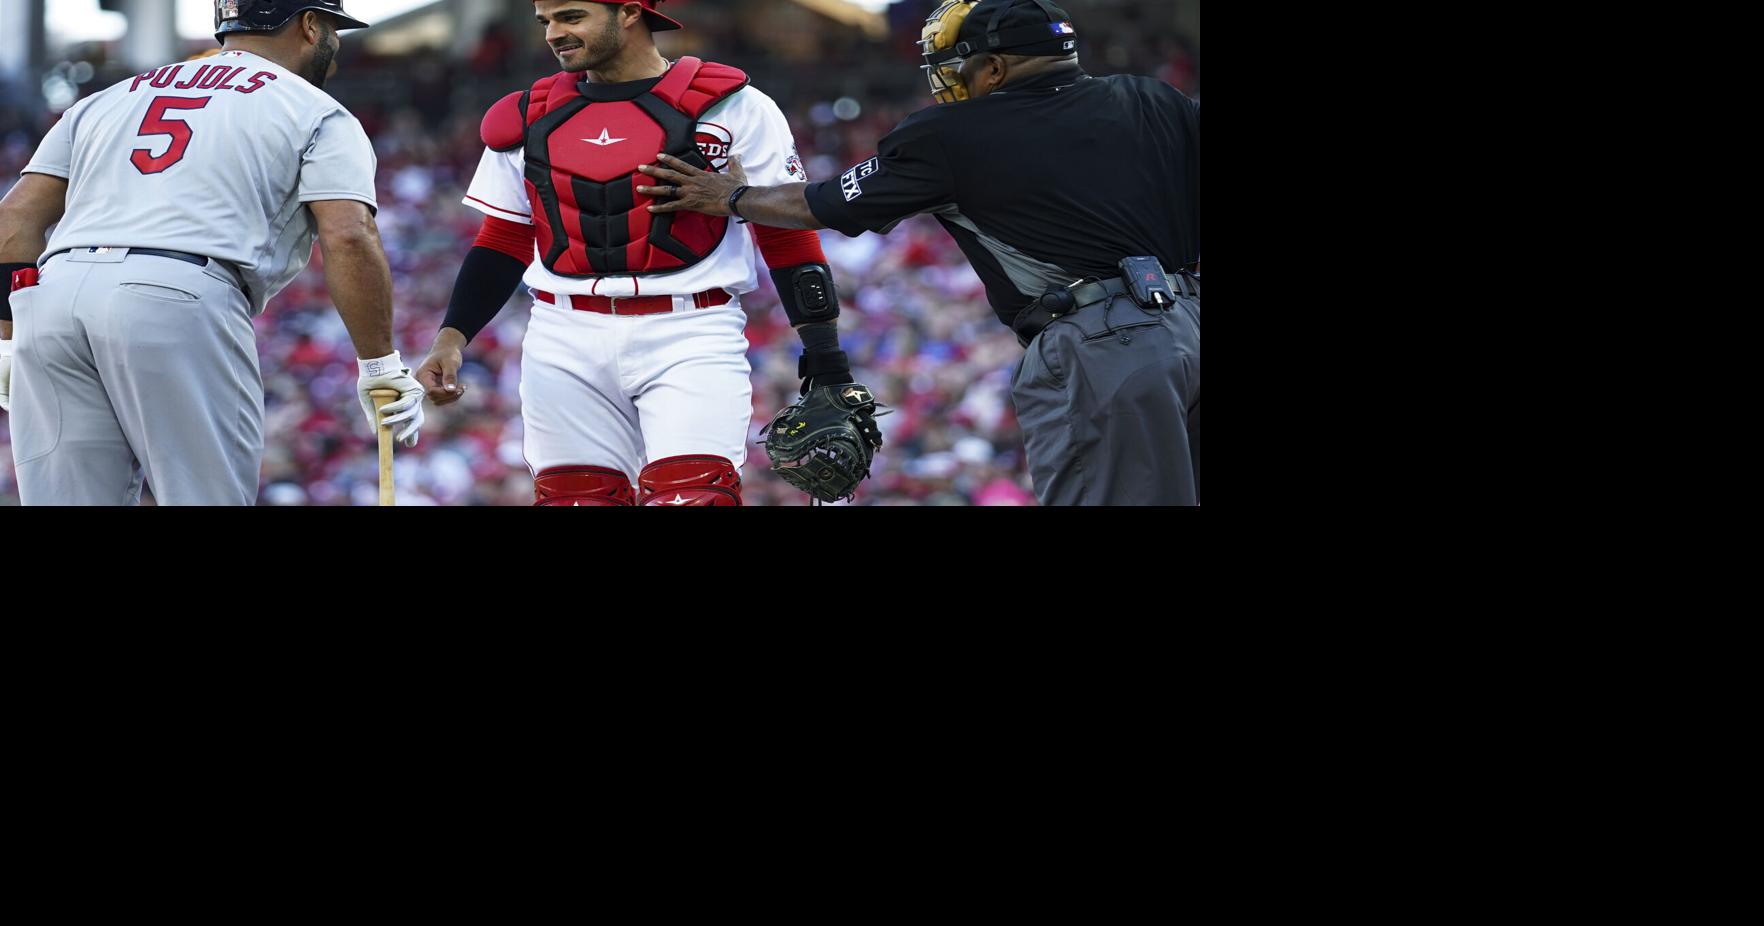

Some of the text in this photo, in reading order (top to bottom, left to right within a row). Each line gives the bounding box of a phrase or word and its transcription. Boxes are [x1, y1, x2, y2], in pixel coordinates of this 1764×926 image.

[129, 65, 277, 93] PUJOLS
[129, 95, 213, 175] 5
[696, 142, 728, 157] EDS
[842, 170, 860, 199] FTX
